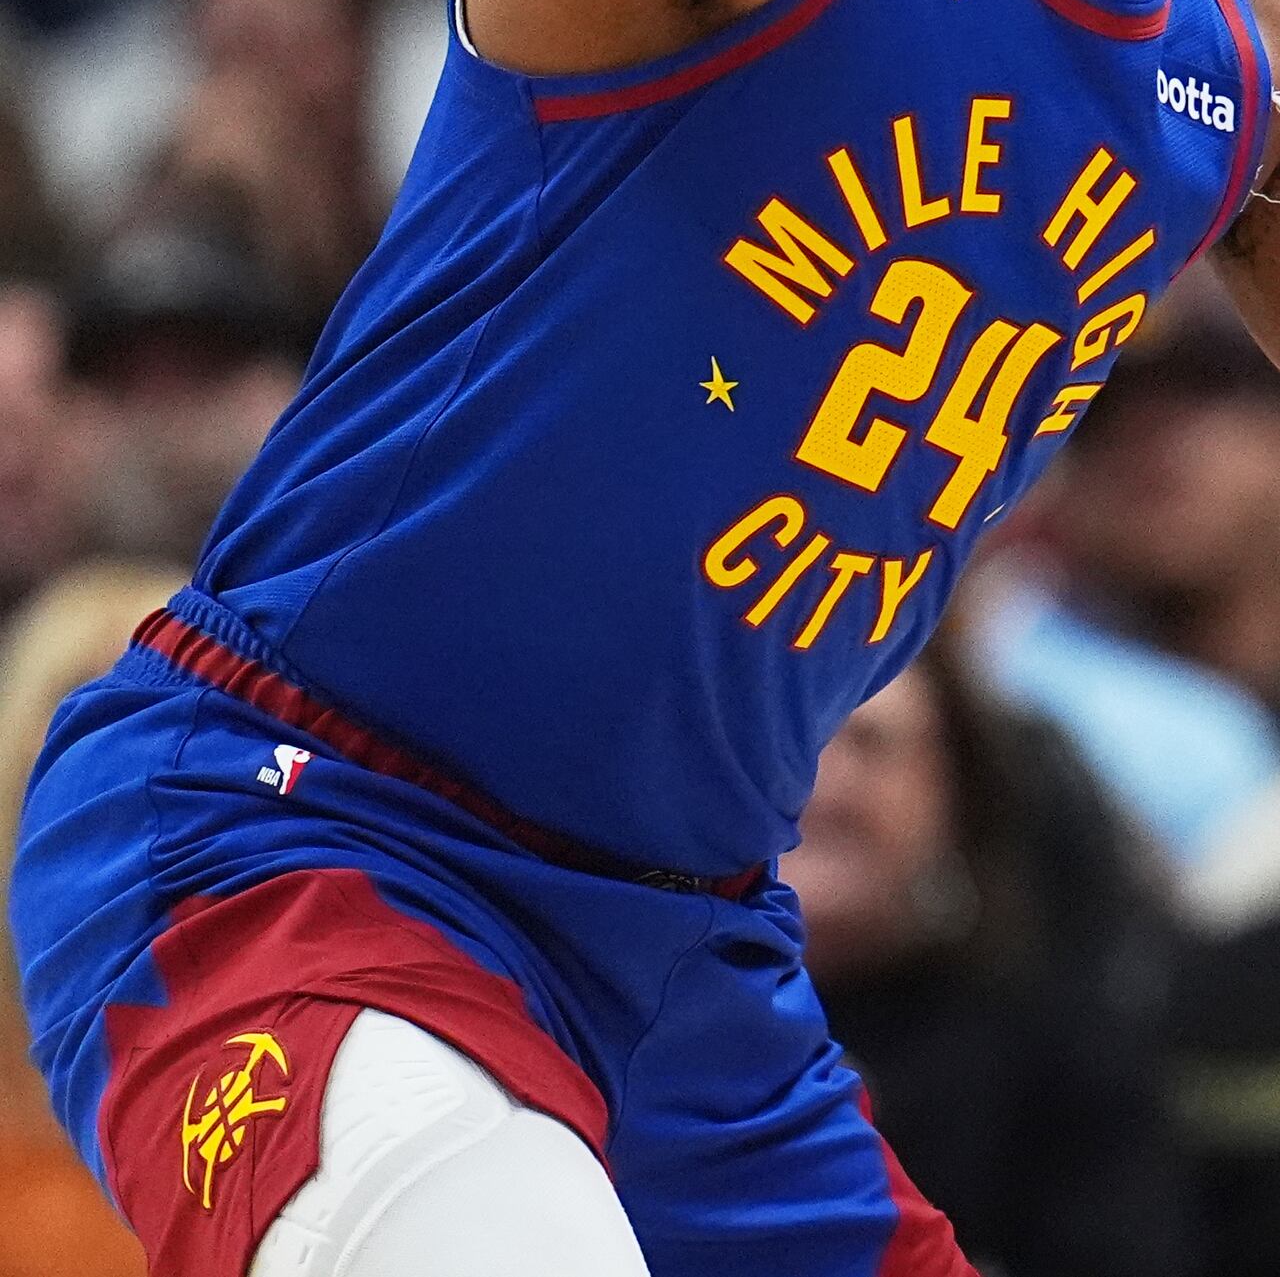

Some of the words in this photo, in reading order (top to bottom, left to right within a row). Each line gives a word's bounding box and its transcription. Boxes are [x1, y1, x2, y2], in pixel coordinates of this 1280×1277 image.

[722, 97, 1013, 326] MILE
[1032, 147, 1158, 437] HIGH
[794, 258, 1063, 530] 24
[703, 495, 934, 650] CITY
[256, 766, 281, 787] NBA
